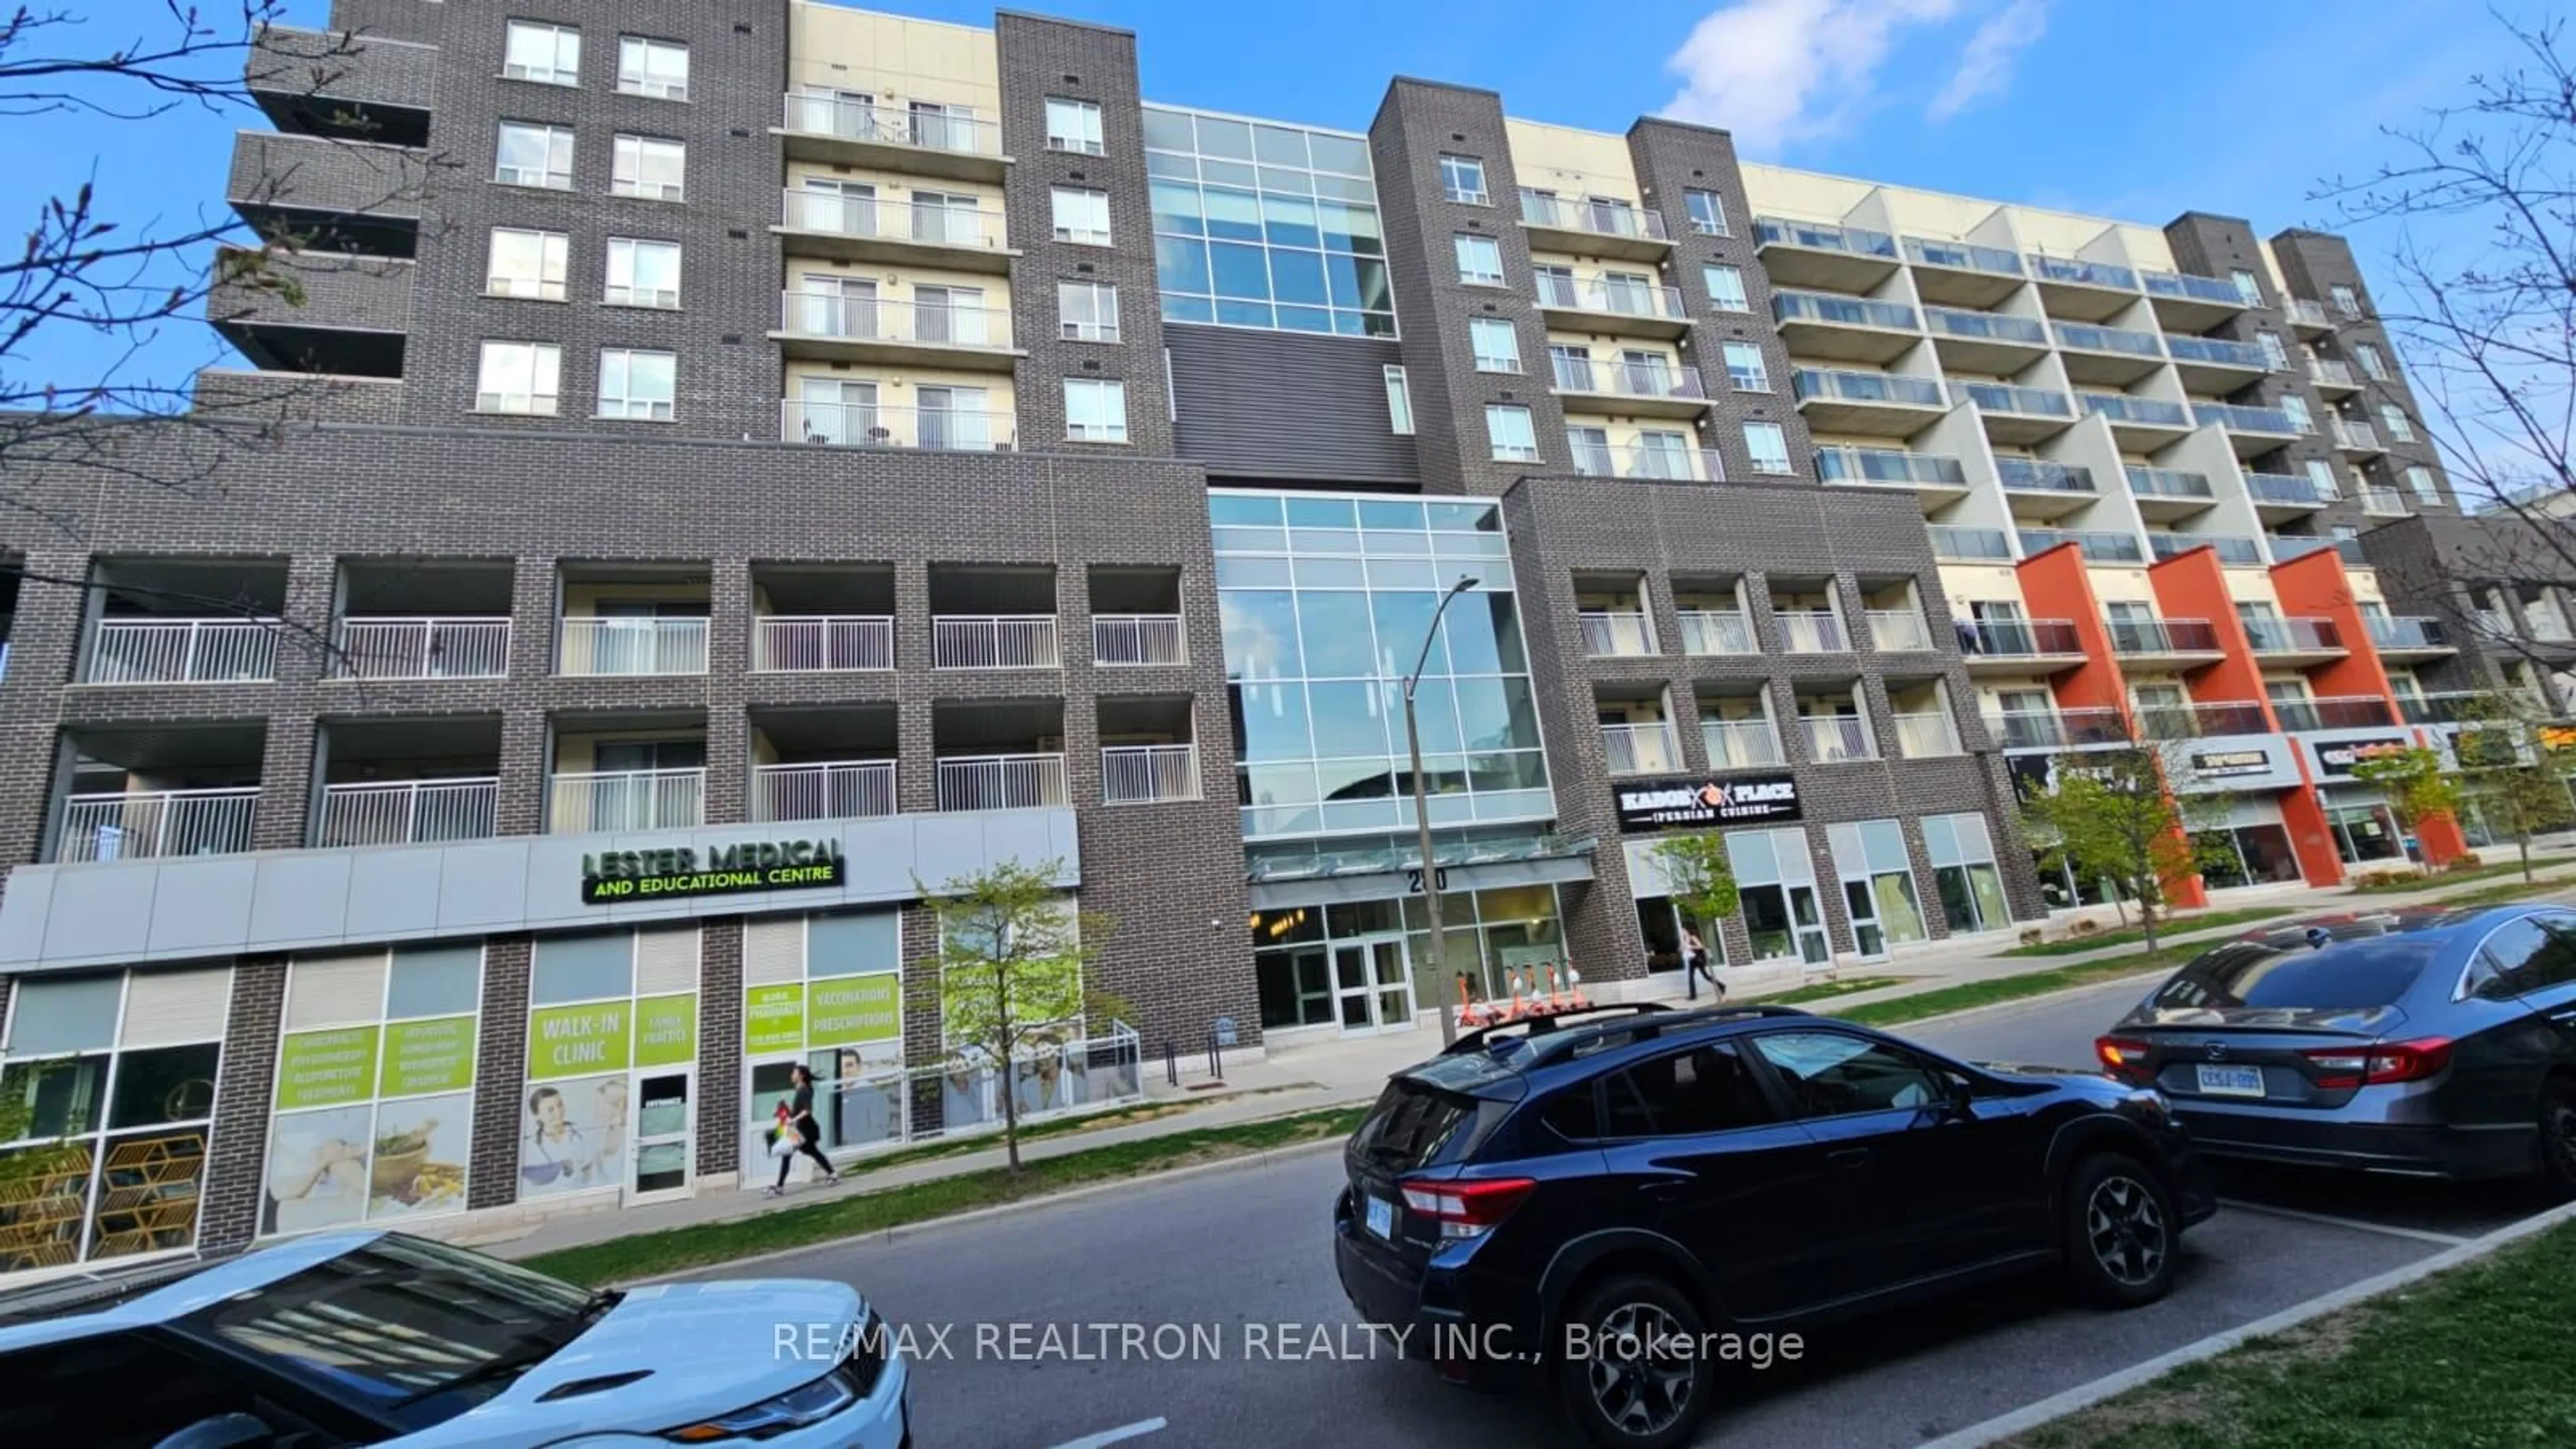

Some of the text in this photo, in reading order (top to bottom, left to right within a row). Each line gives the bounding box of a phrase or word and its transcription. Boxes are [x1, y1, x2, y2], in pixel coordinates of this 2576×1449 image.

[1734, 782, 1794, 802] PLACE
[583, 837, 841, 877] LESTER MEDICAL
[594, 866, 833, 896] AND EDUCATIONAL CENTRE
[817, 986, 890, 1006] VACCINATIONS
[542, 1012, 620, 1040] WALK-IN
[813, 1012, 894, 1030] PRESCRIPTIONS
[553, 1040, 606, 1065] CLINIC
